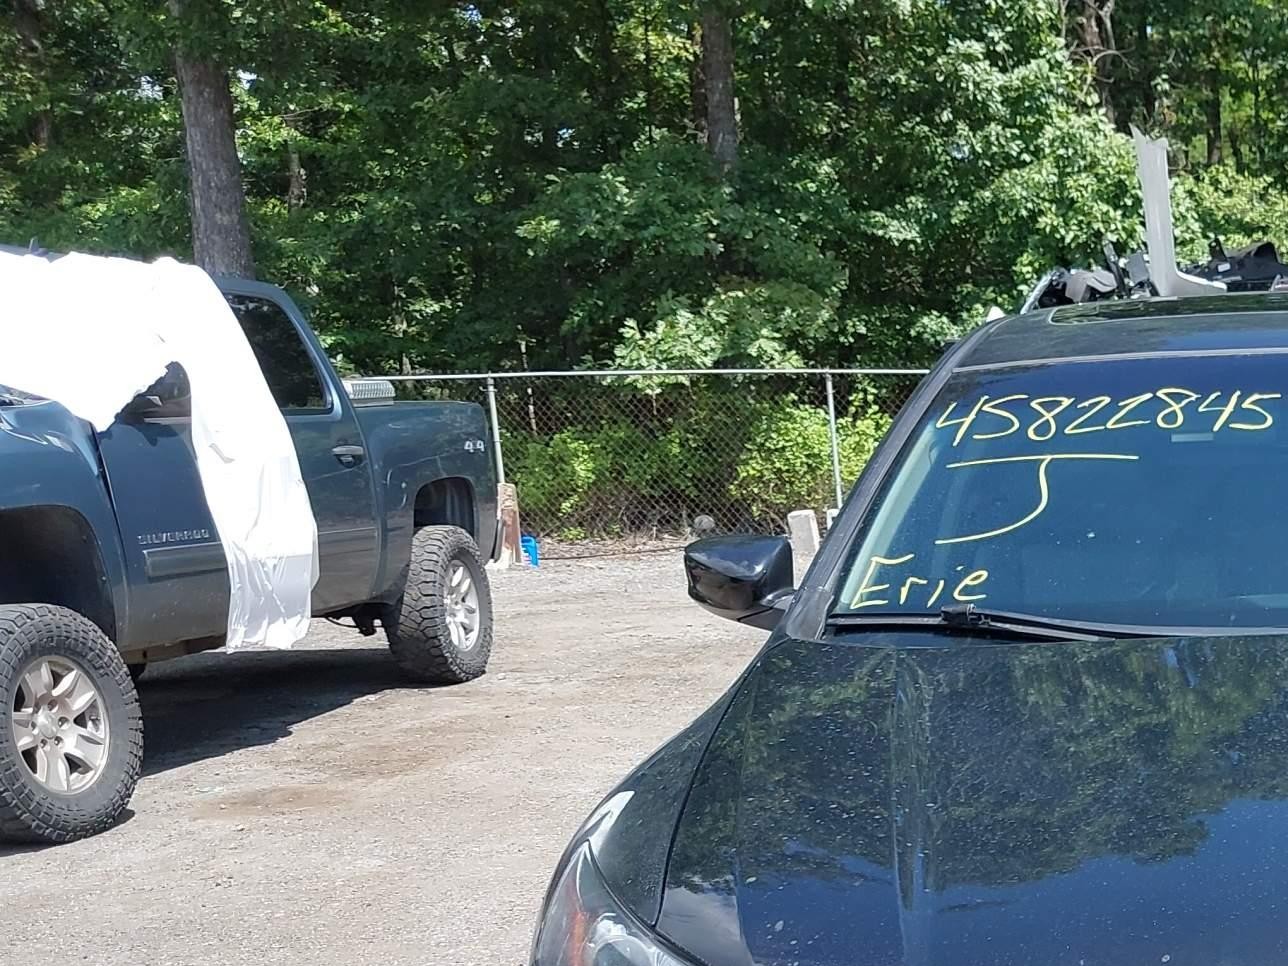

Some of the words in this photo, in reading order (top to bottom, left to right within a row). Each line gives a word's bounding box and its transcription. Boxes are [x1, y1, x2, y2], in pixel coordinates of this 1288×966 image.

[935, 387, 1282, 447] 45822845
[463, 440, 485, 453] 44
[849, 553, 989, 609] Erie
